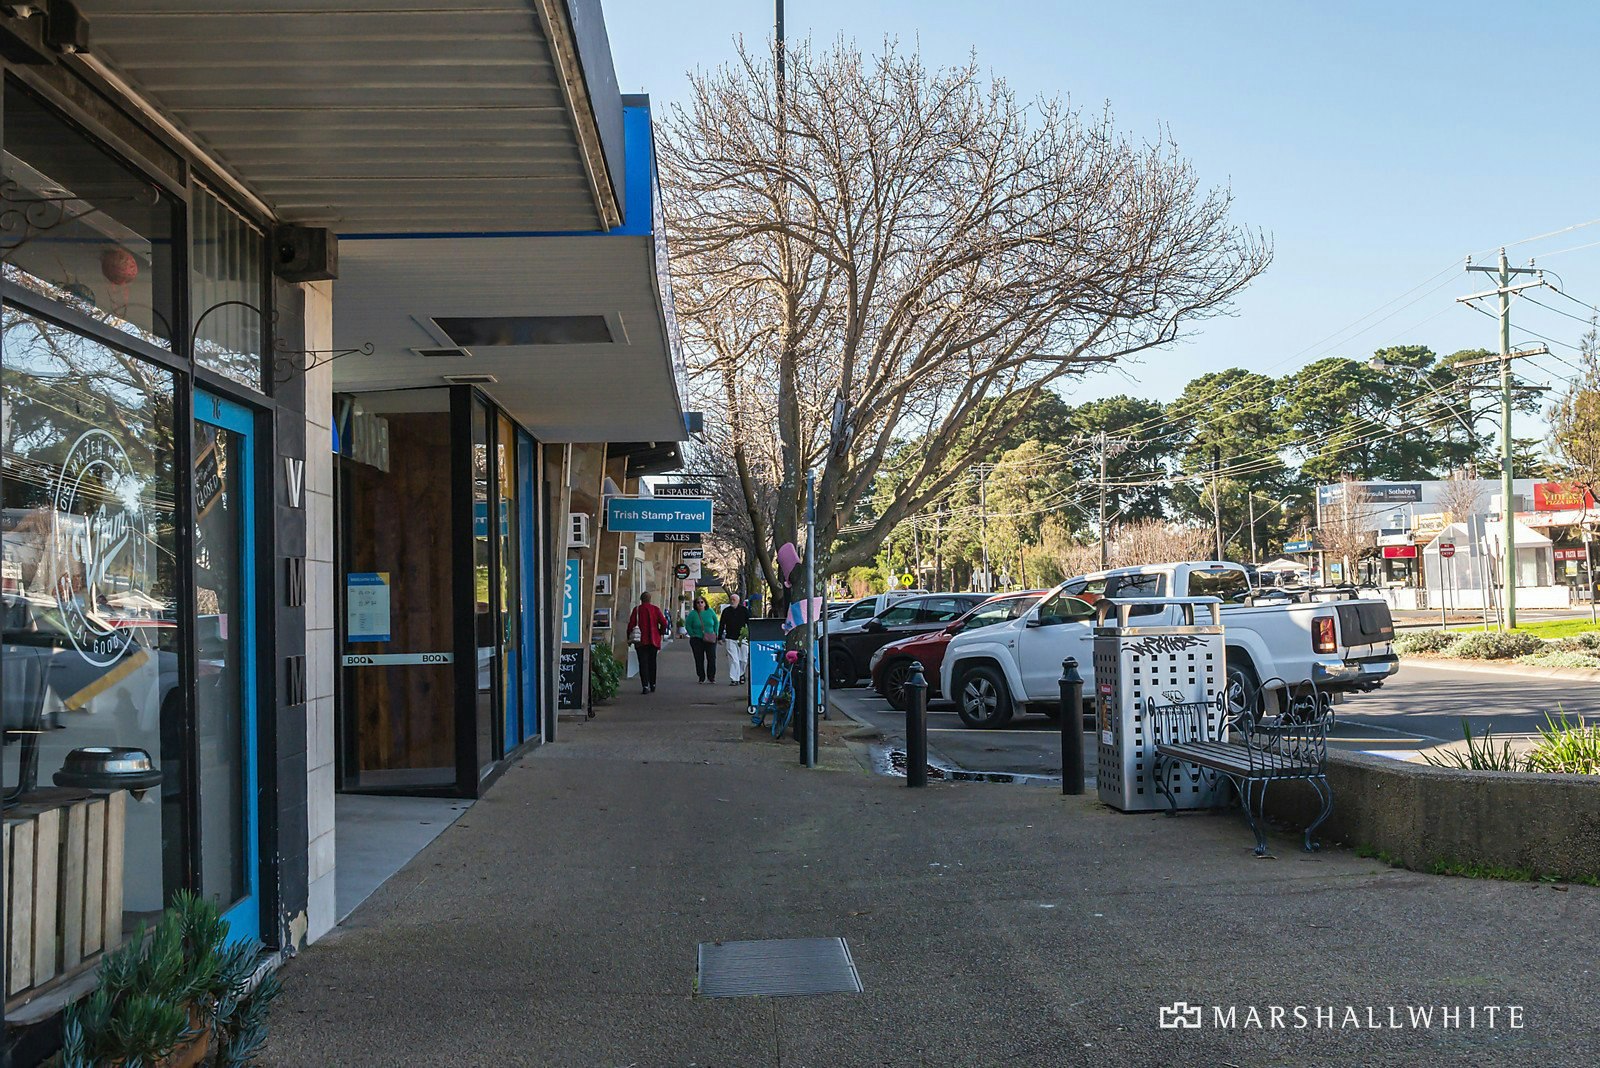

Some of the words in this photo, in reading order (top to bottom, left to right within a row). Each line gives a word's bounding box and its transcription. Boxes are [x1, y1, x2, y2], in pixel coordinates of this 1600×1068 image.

[1388, 488, 1416, 497] Sotheby's
[614, 510, 639, 520] Trish
[641, 510, 674, 522] Stamp
[674, 511, 705, 521] Travel
[664, 533, 690, 541] SALES
[93, 635, 119, 655] GOOD
[347, 656, 367, 665] BOQ
[422, 654, 442, 663] BOQ
